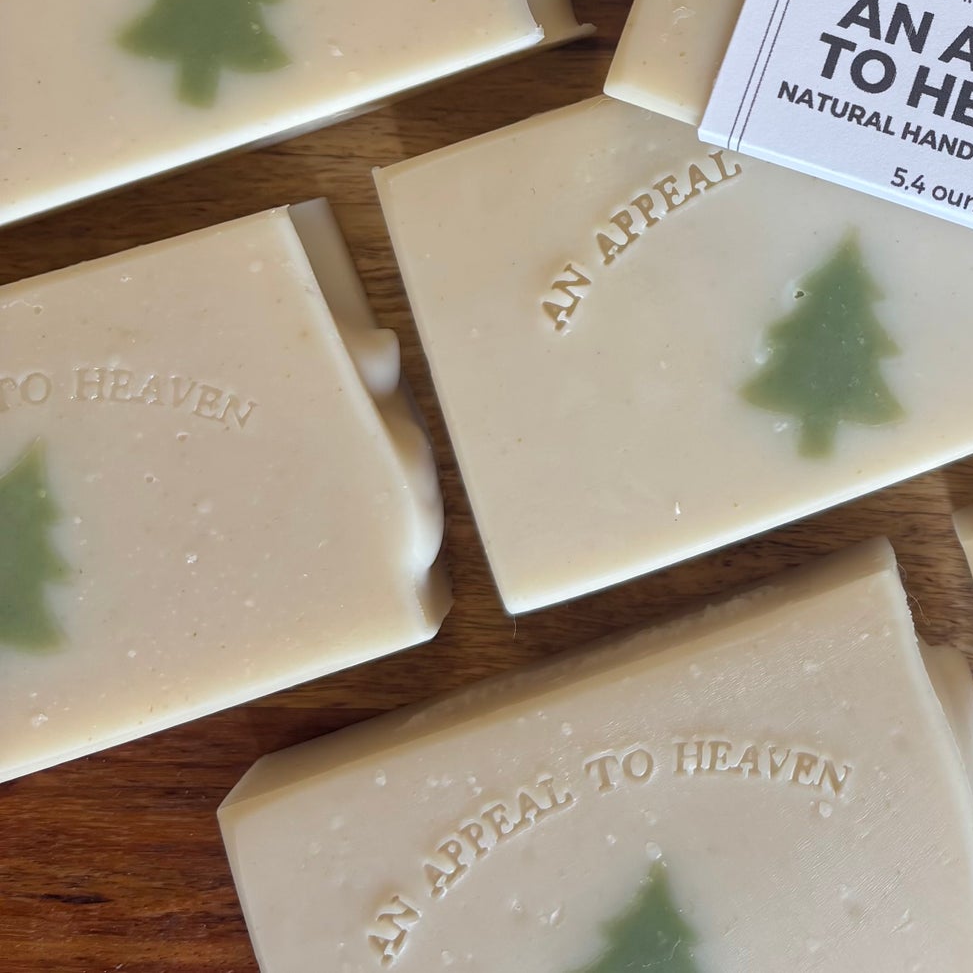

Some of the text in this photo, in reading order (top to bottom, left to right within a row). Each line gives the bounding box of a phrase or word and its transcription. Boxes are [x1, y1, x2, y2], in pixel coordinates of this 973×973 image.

[819, 33, 898, 95] TO
[778, 80, 896, 137] NATURAL
[891, 167, 926, 197] 5.4
[542, 150, 742, 331] AN APPEAL
[71, 363, 259, 429] HEAVEN
[367, 740, 852, 968] AN APPEAL TO HEAVEN
